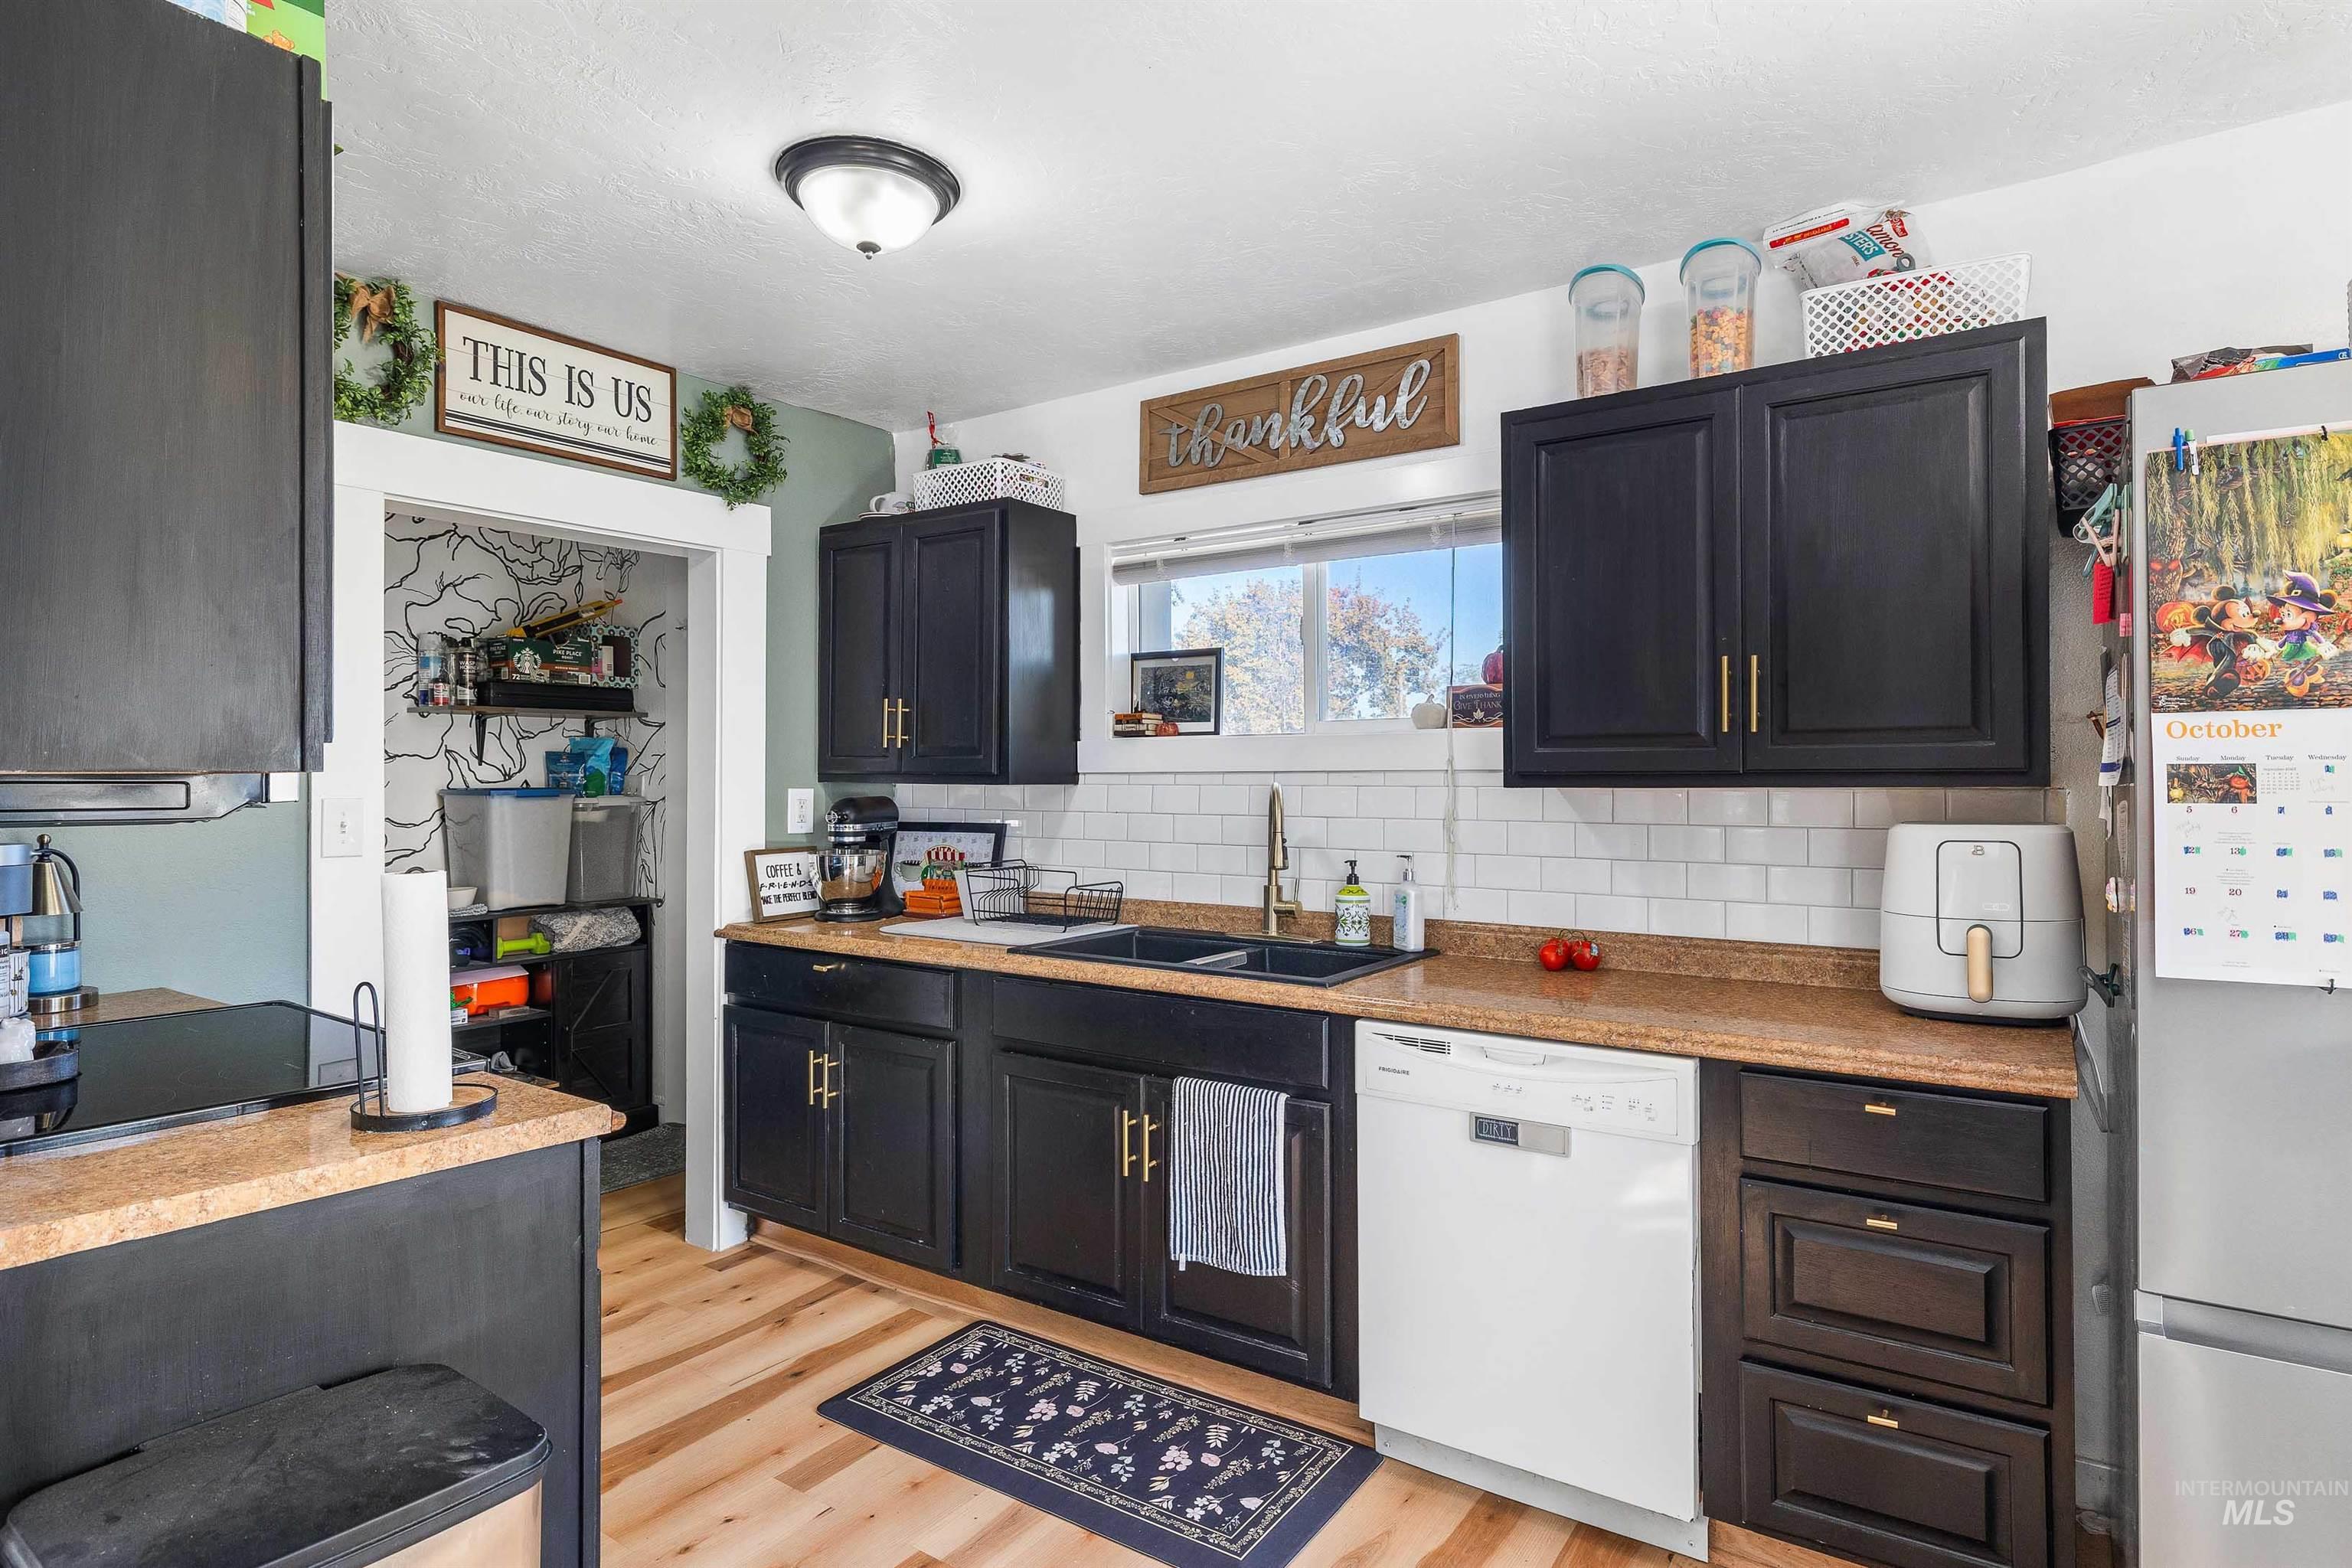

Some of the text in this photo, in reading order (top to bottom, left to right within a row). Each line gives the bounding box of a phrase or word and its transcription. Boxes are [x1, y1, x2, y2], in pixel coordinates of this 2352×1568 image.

[1844, 231, 1879, 255] STERS
[462, 336, 652, 423] THIS IS US
[459, 393, 488, 406] our
[526, 408, 552, 421] our
[597, 426, 622, 437] our
[1158, 358, 1432, 468] thankful
[1453, 699, 1502, 710] GIVE THANK
[2166, 720, 2282, 740] October
[766, 863, 802, 878] COFFEE &
[773, 893, 782, 903] THE
[782, 892, 801, 903] PERFECT
[2185, 887, 2196, 895] 19
[2229, 888, 2243, 897] 20
[2230, 929, 2242, 938] 27
[1378, 1066, 1410, 1076] FRIGIDAIRE
[1482, 1122, 1512, 1138] DIRTY
